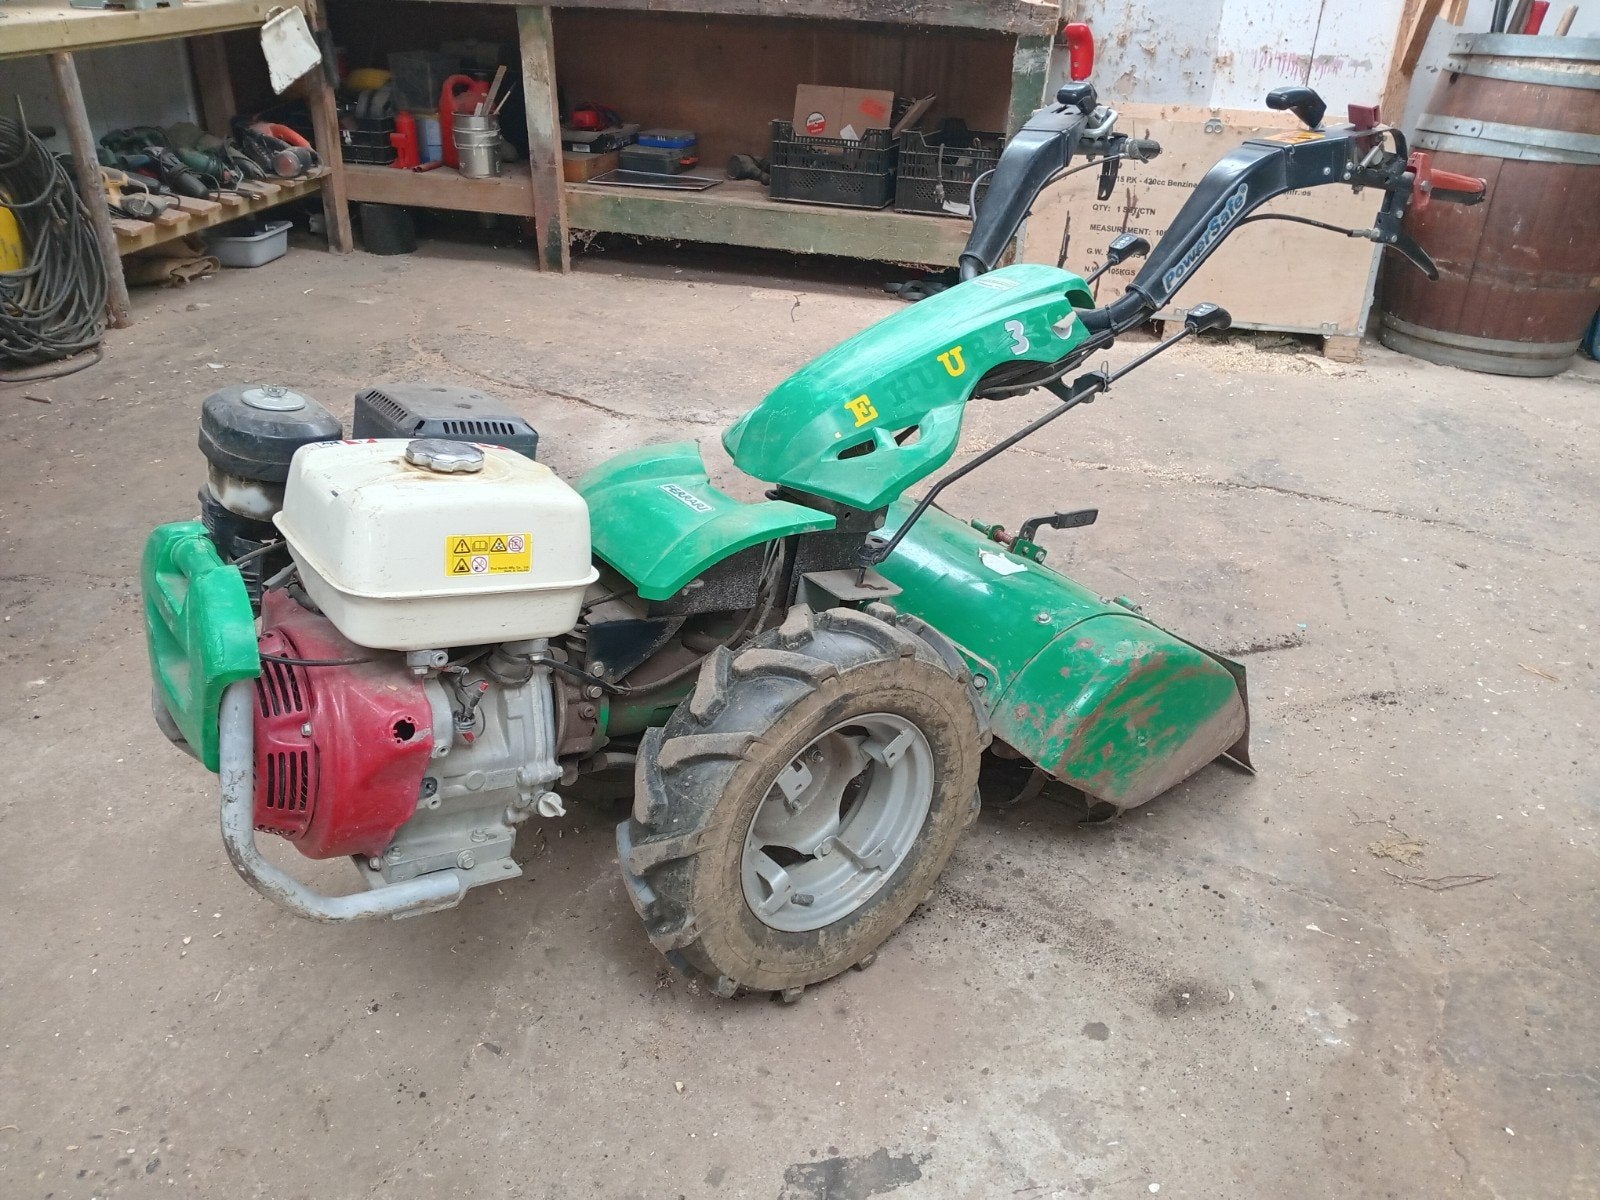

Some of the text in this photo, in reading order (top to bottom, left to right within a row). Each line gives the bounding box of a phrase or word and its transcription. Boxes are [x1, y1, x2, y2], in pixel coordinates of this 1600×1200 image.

[1092, 203, 1111, 213] QTY:
[1089, 223, 1152, 236] MEASUREMENT:
[662, 484, 710, 511] FERRARI
